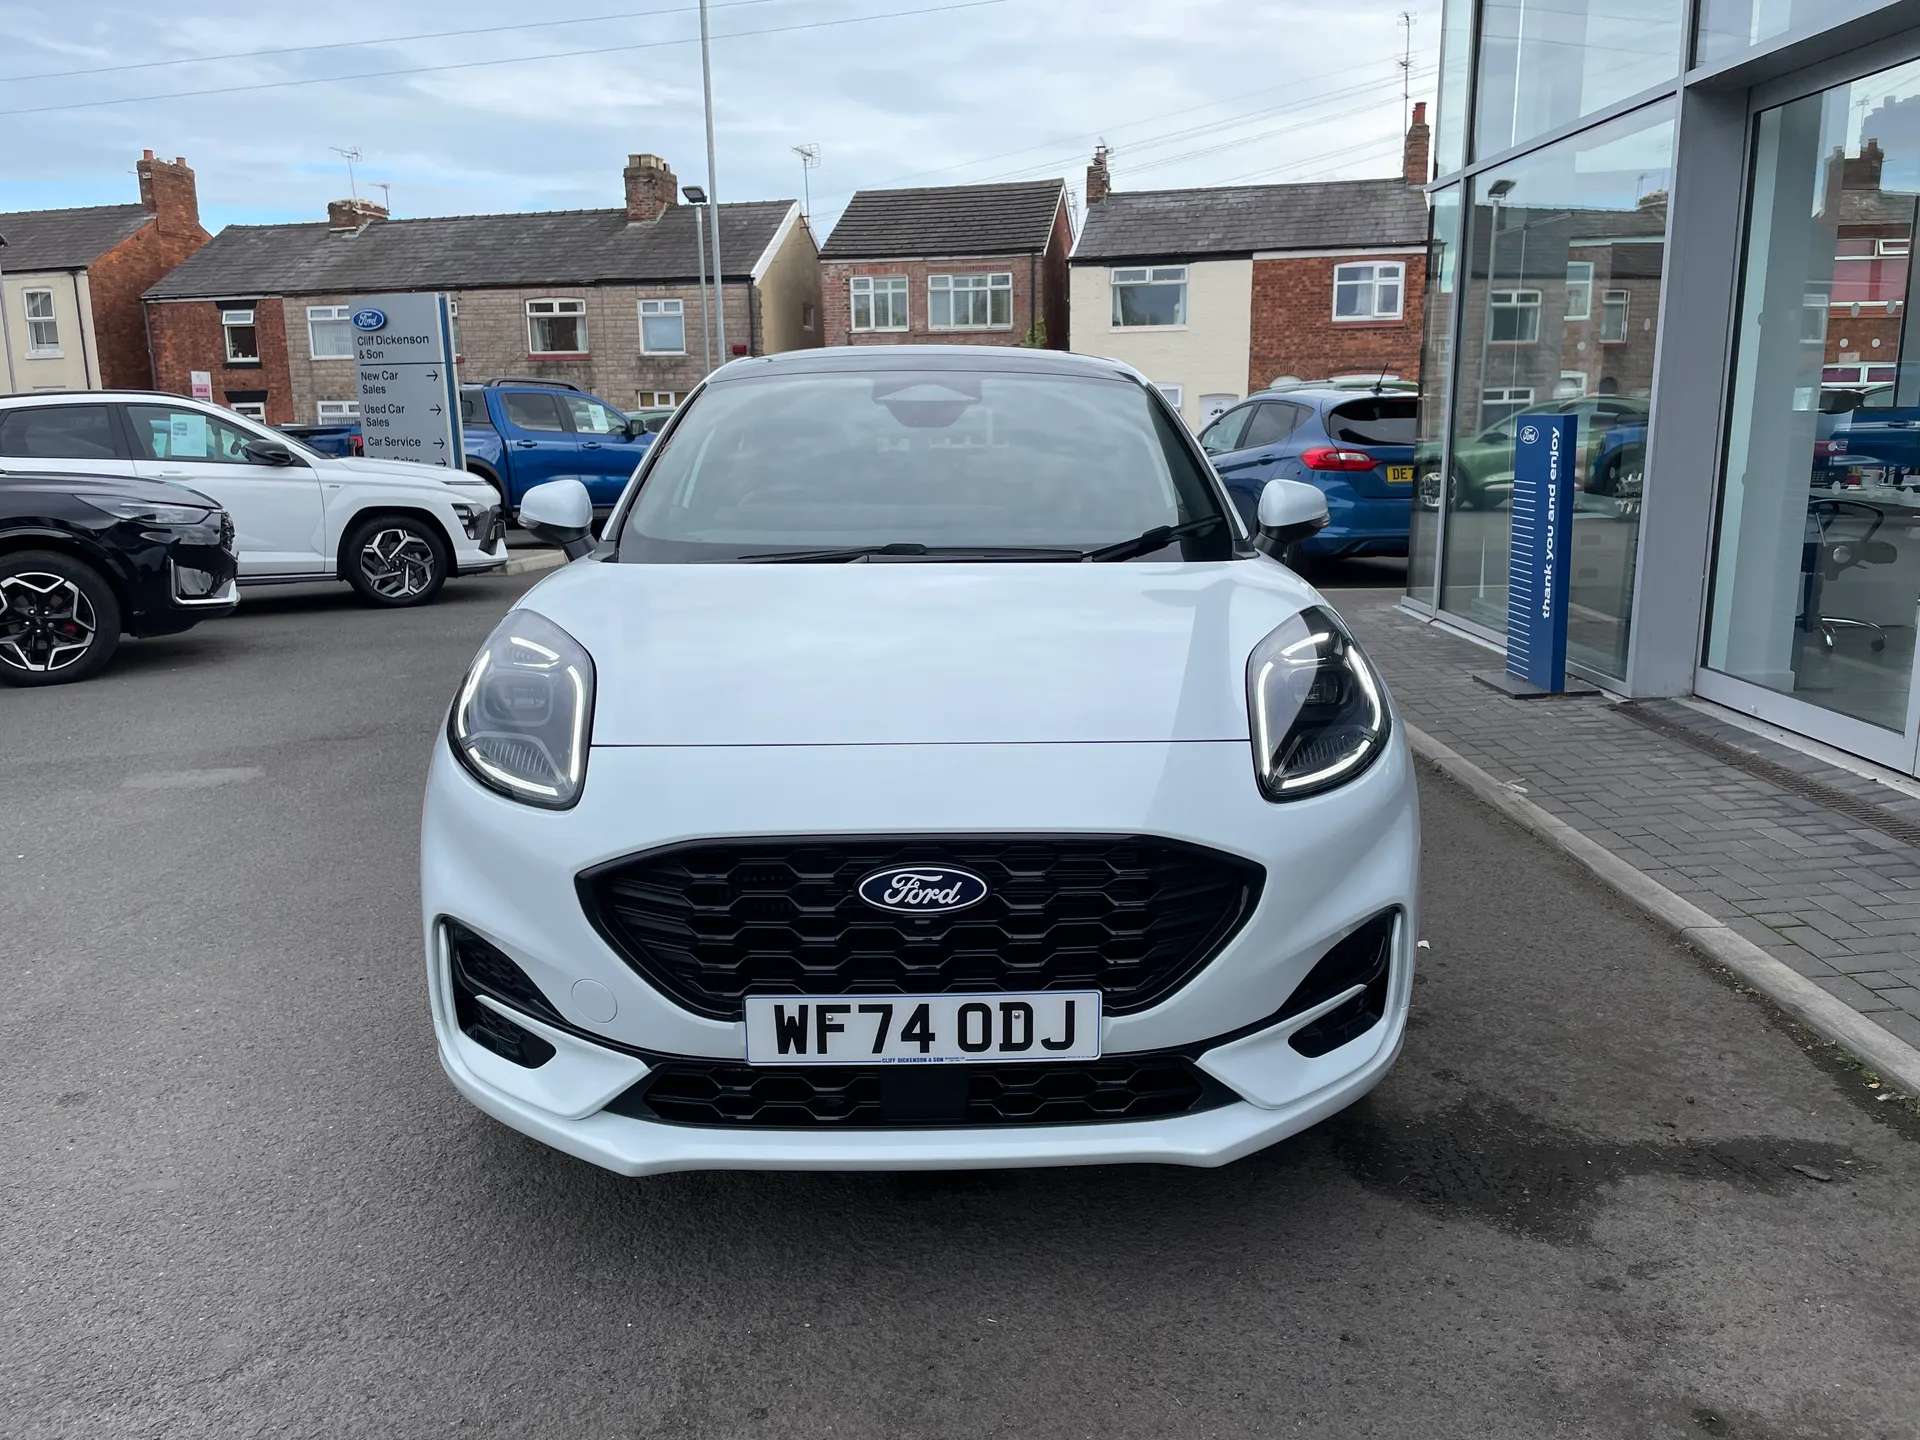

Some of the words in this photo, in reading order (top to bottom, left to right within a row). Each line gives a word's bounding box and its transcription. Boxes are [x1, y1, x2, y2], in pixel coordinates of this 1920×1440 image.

[357, 335, 374, 346] Cliff
[376, 335, 430, 345] Dickenson
[359, 350, 365, 360] &
[366, 350, 384, 359] Son
[360, 371, 380, 381] New
[381, 370, 398, 381] Car
[362, 384, 387, 394] Sales
[364, 404, 386, 414] Used
[388, 403, 405, 414] Car
[366, 417, 390, 427] Sales
[368, 436, 382, 446] Car
[384, 436, 422, 447] Service
[1549, 426, 1560, 481] enjoy
[1548, 483, 1556, 522] and
[1546, 525, 1554, 561] you
[1542, 563, 1552, 619] thank
[883, 873, 962, 904] Ford
[774, 1003, 936, 1055] WF74
[957, 1000, 1076, 1052] ODJ
